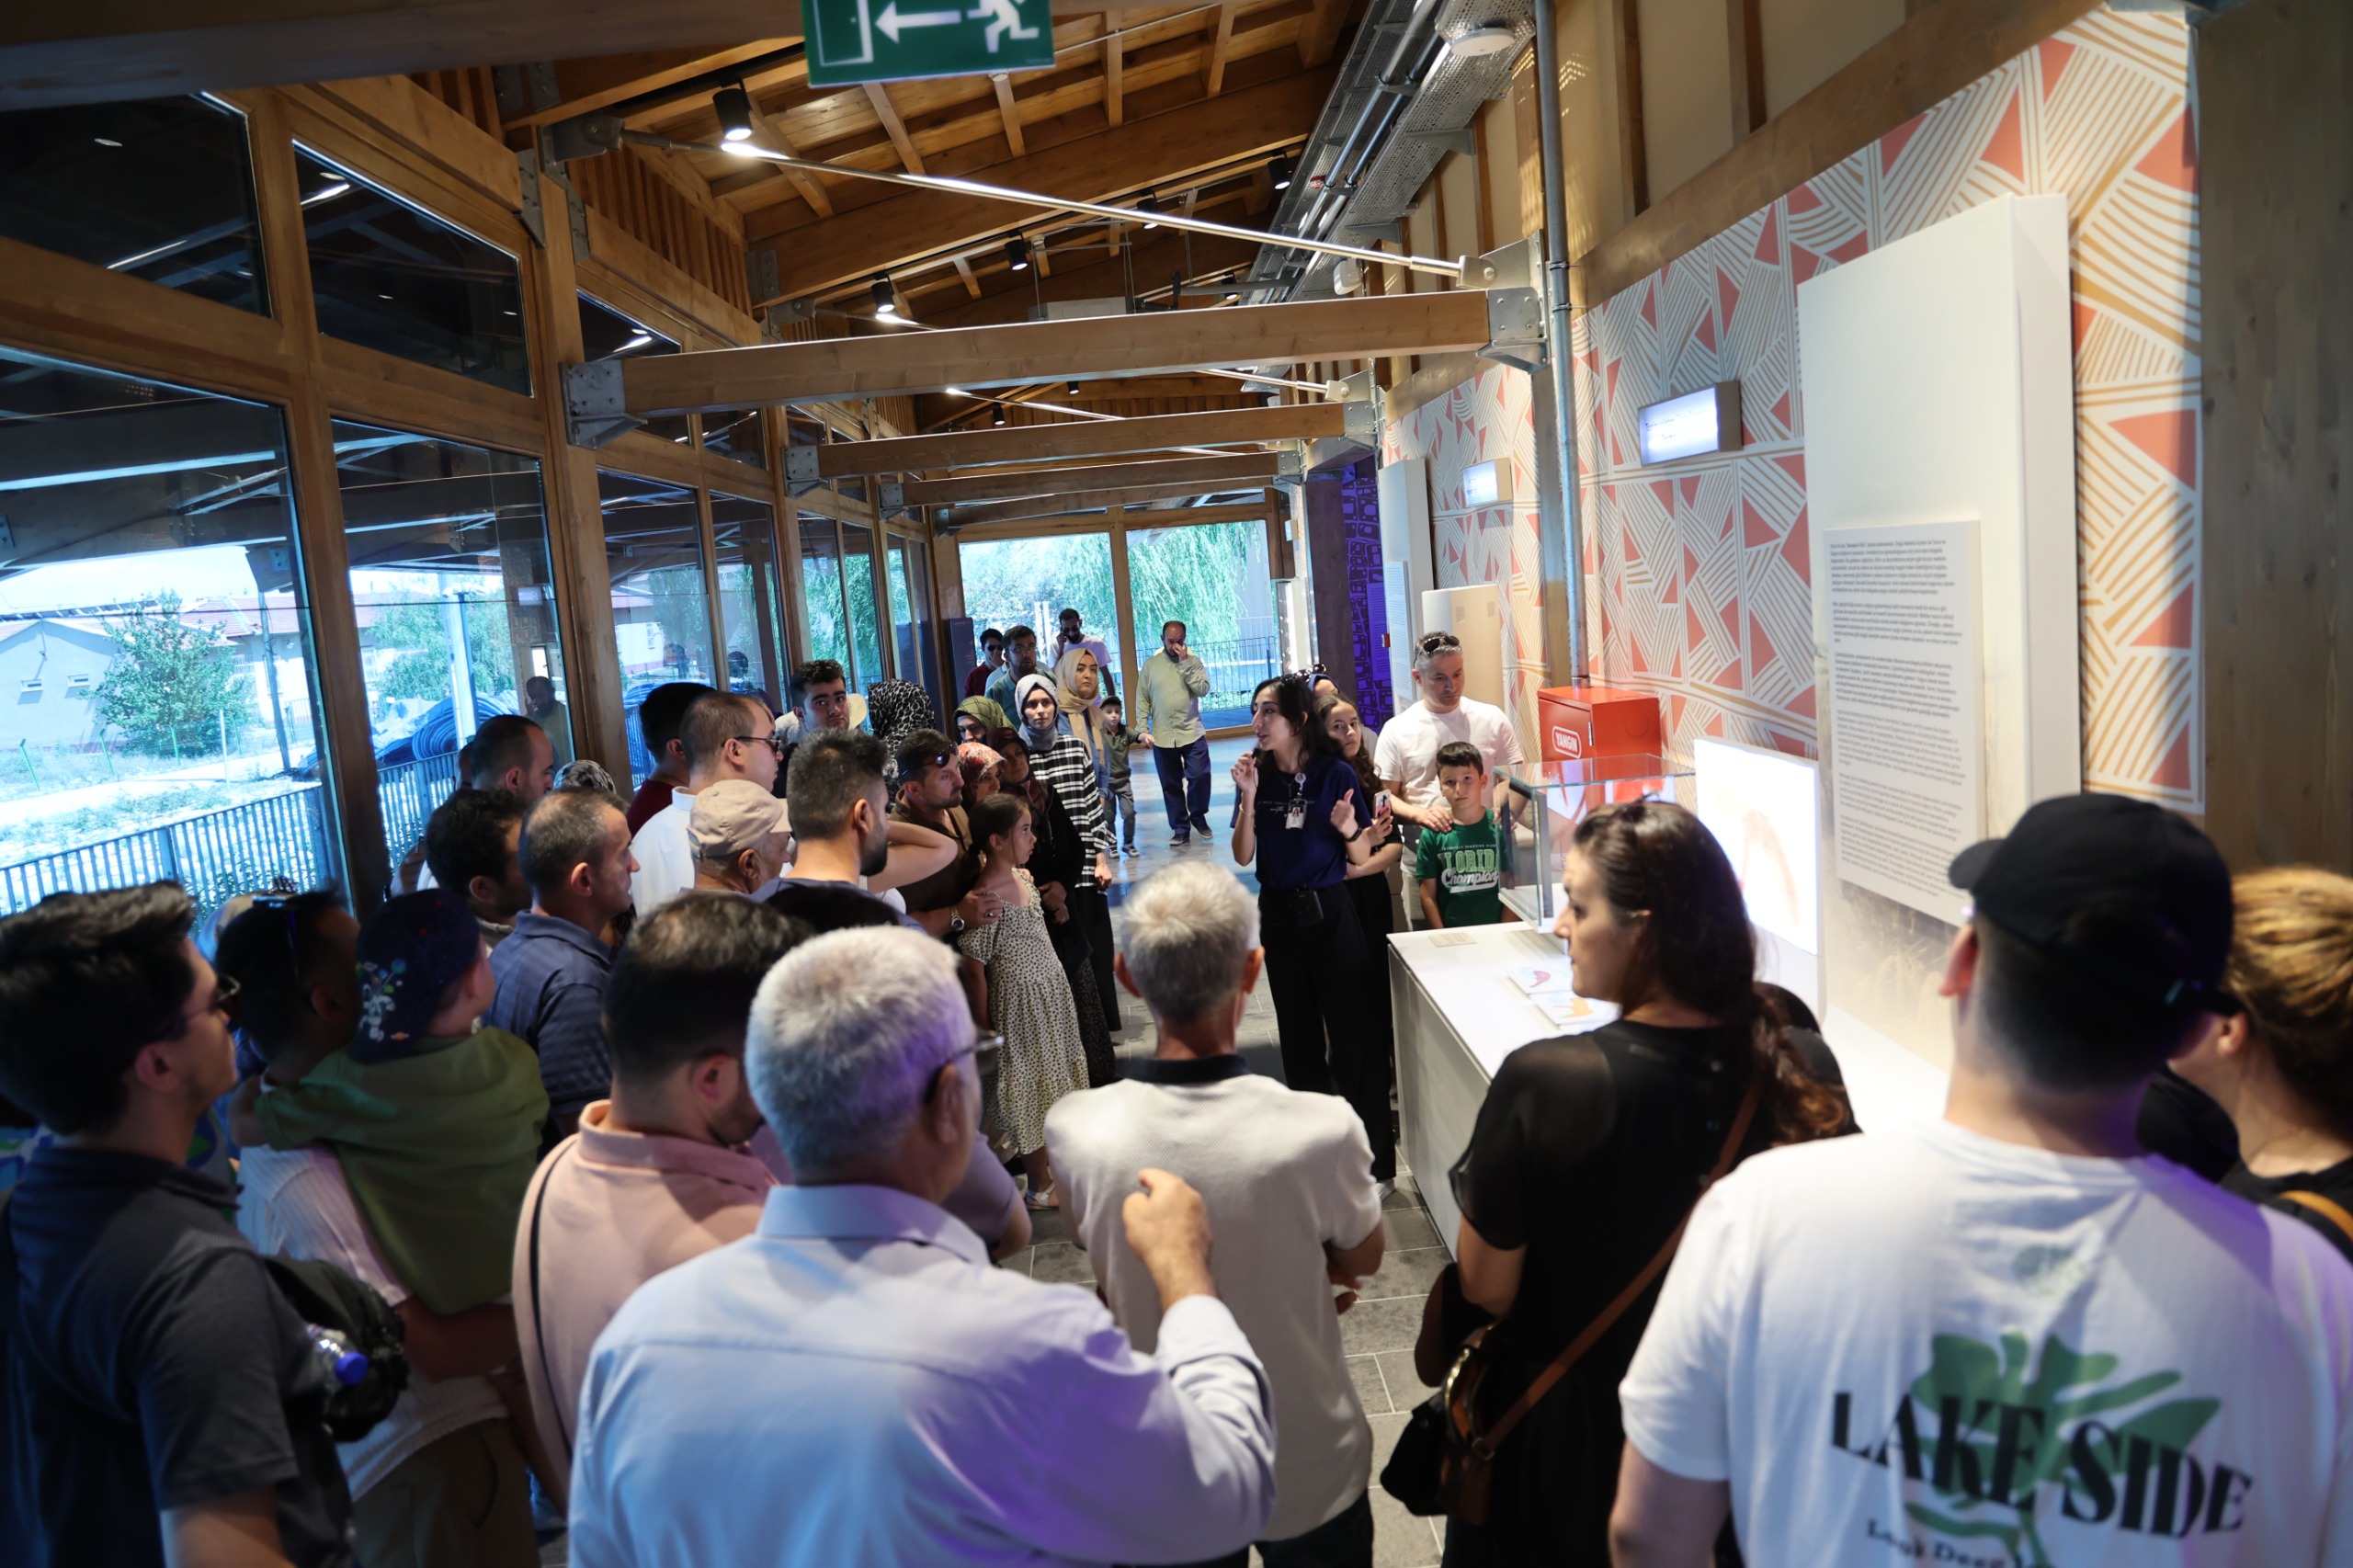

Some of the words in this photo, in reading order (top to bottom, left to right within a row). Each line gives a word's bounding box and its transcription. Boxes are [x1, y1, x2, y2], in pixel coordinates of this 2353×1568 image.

[1555, 732, 1577, 753] YANGIN
[1437, 848, 1497, 873] LORID
[1832, 1392, 2045, 1512] LAKE
[2061, 1420, 2254, 1540] SIDE
